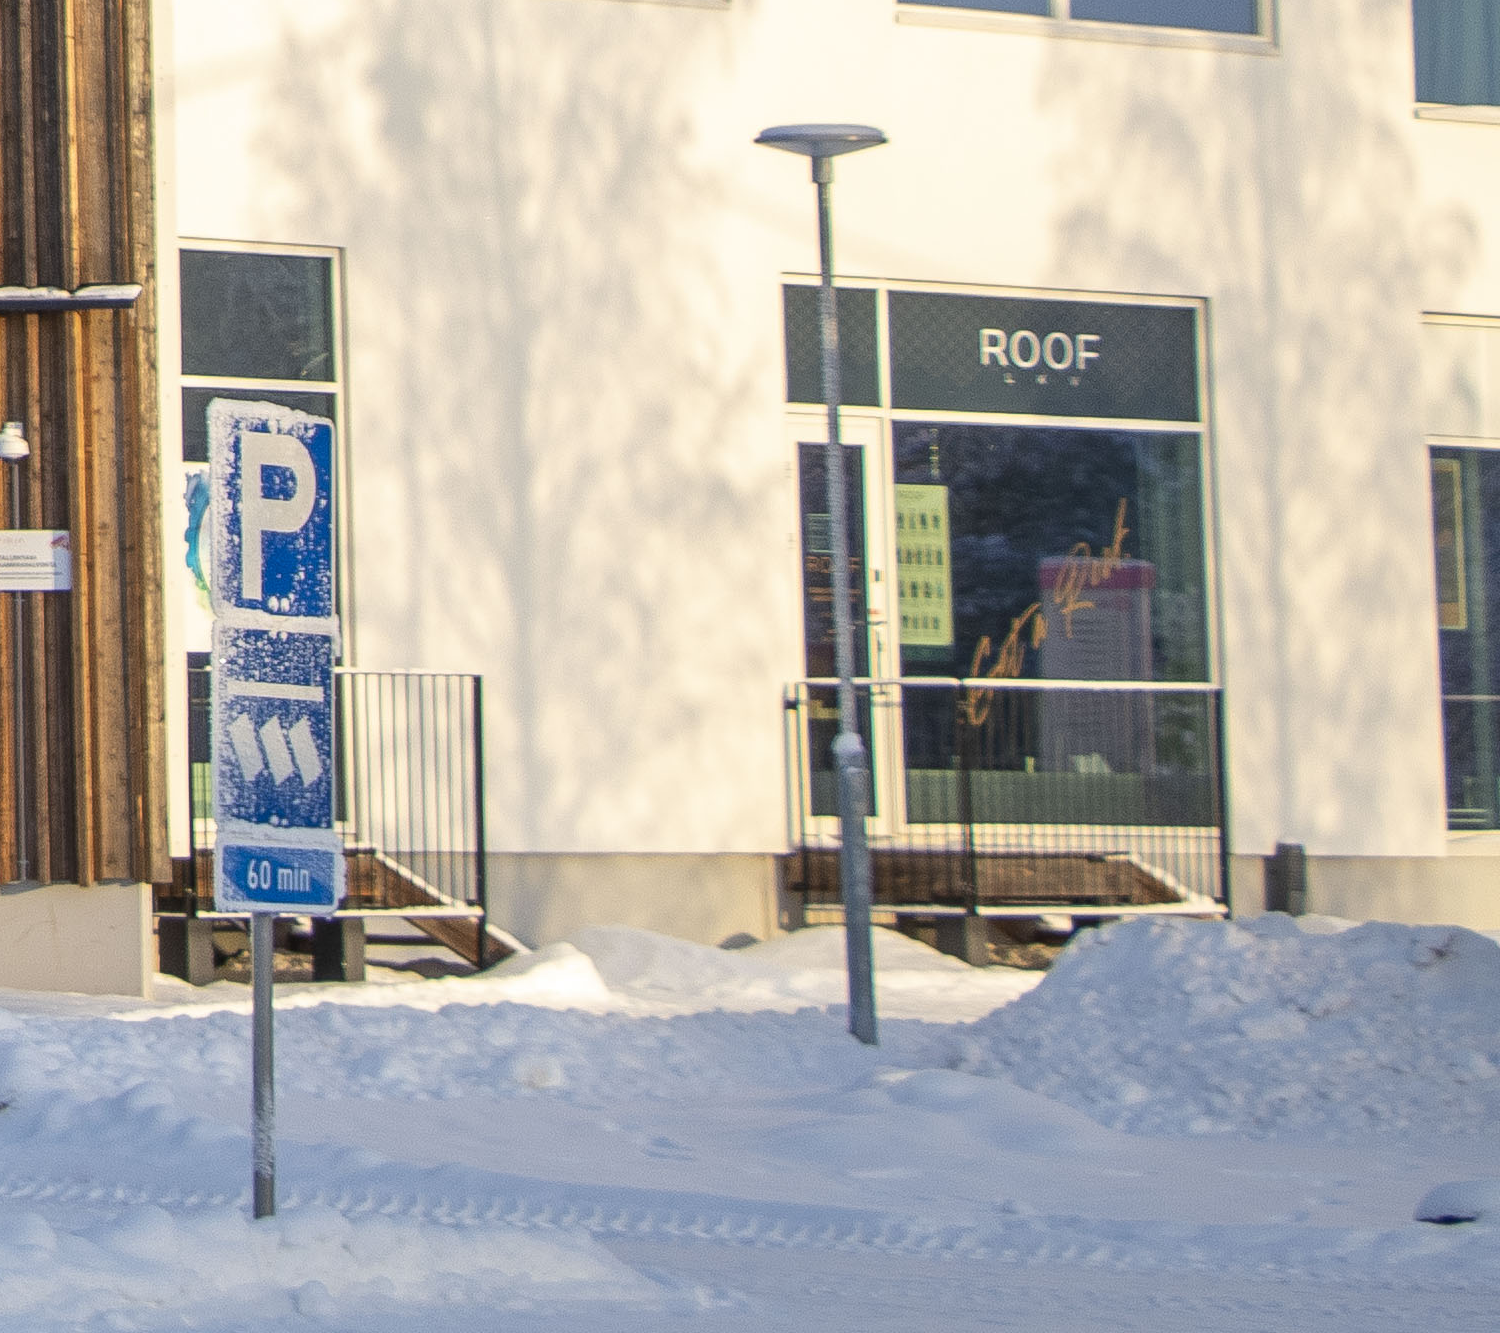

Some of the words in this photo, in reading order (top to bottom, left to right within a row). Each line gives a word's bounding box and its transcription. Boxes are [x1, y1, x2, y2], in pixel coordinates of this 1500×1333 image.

[979, 328, 1101, 370] ROOF
[241, 430, 316, 600] P
[247, 858, 272, 890] 60
[277, 862, 311, 891] min
